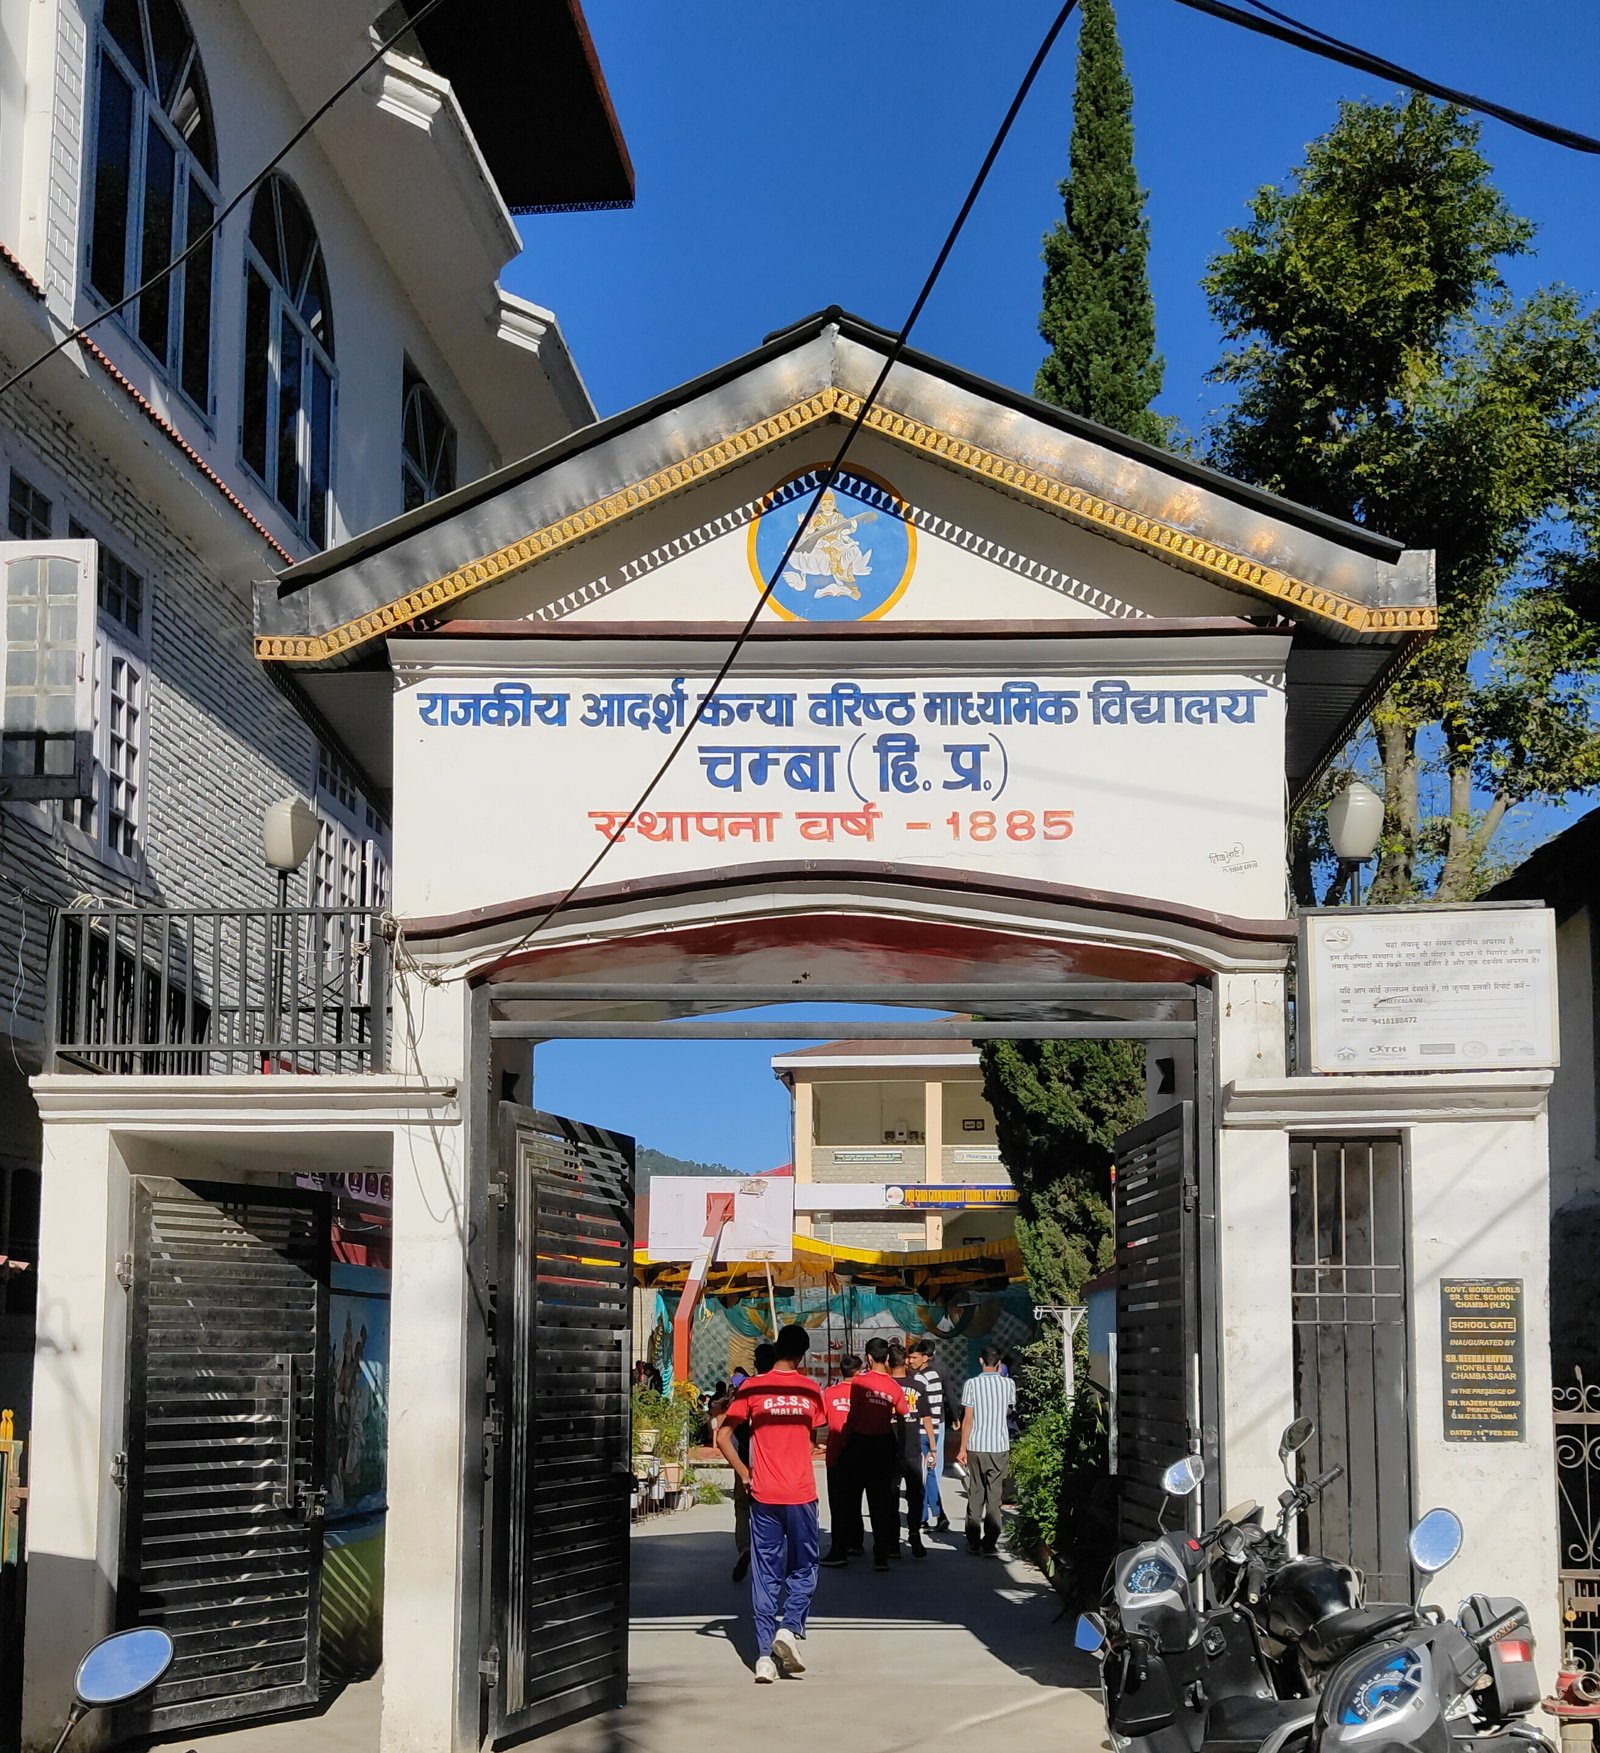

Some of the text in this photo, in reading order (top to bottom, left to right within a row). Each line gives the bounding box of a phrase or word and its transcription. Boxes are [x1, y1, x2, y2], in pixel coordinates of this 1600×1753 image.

[417, 677, 1267, 734] राजकीय आदर्श कन्या वरिष्ठ माध्यमिक विद्यालय
[698, 746, 840, 792] चम्बा
[796, 802, 882, 842] वर्ष
[946, 810, 1075, 842] 1885
[764, 1395, 810, 1409] G.S.S.S
[770, 1408, 804, 1416] MALAL
